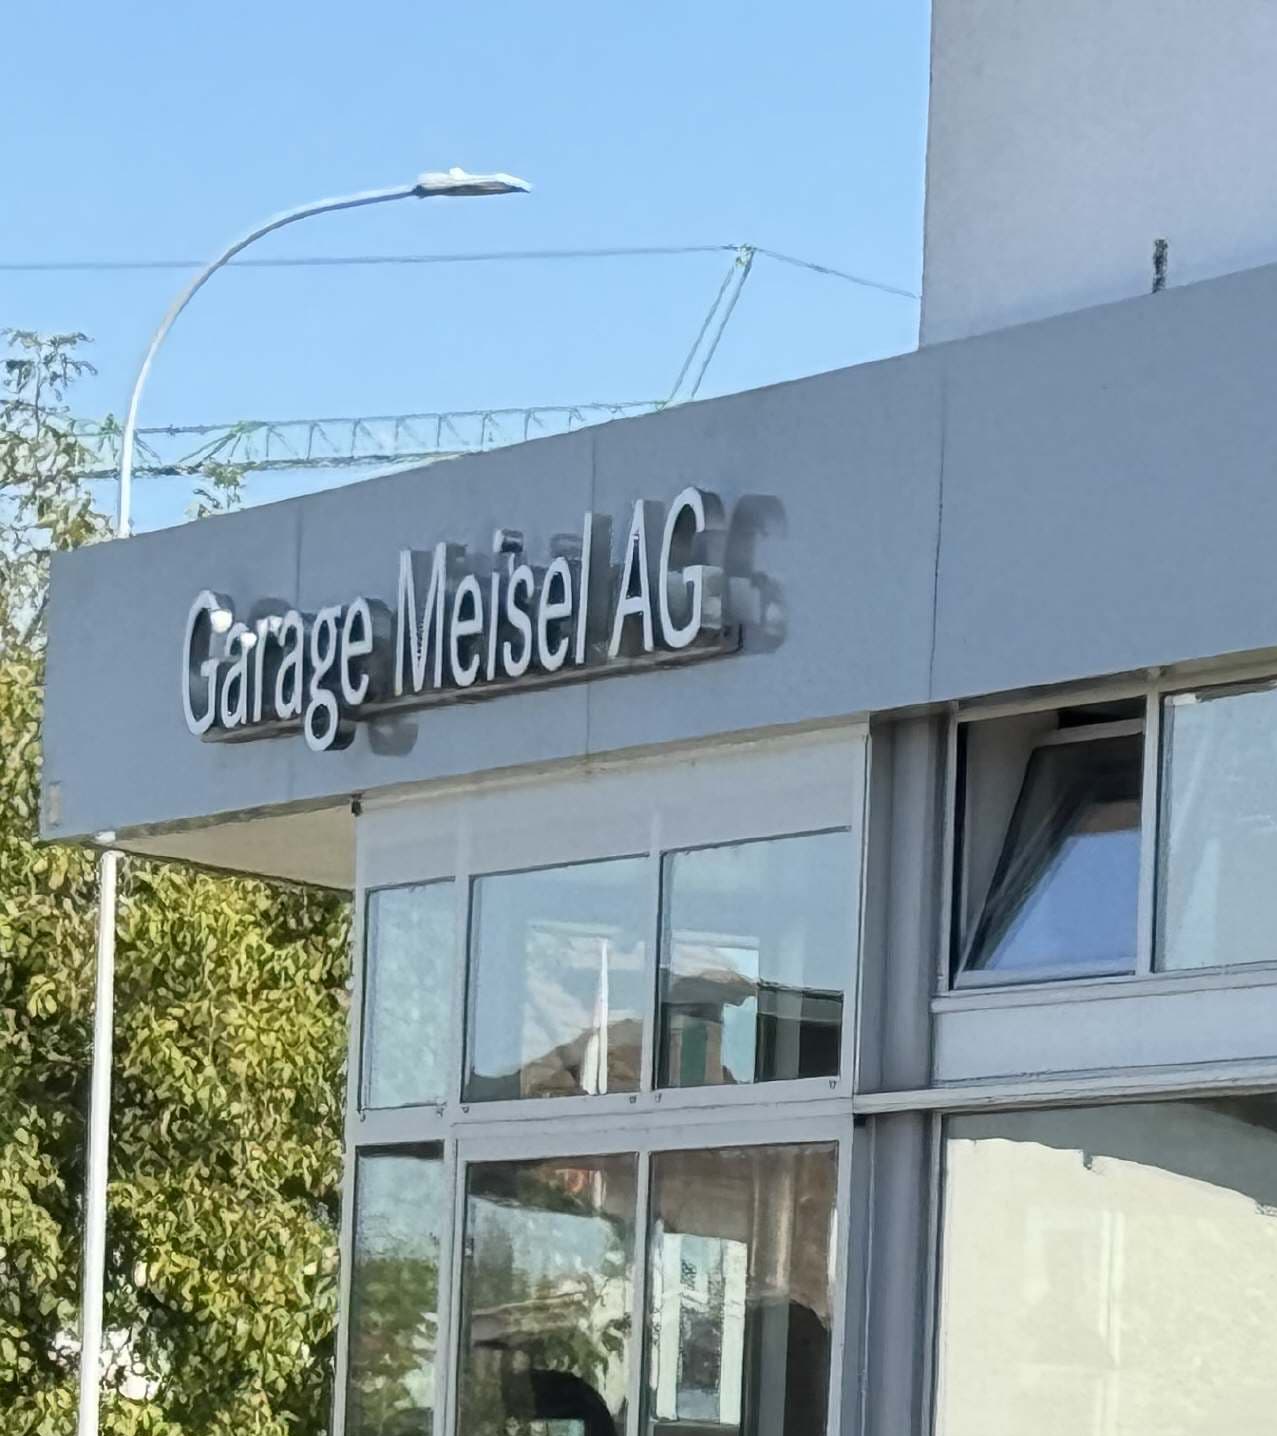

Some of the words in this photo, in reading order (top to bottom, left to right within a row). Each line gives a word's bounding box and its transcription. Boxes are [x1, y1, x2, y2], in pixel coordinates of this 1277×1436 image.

[182, 589, 374, 752] Garage
[394, 511, 594, 696] Meisel
[609, 487, 708, 661] AG
